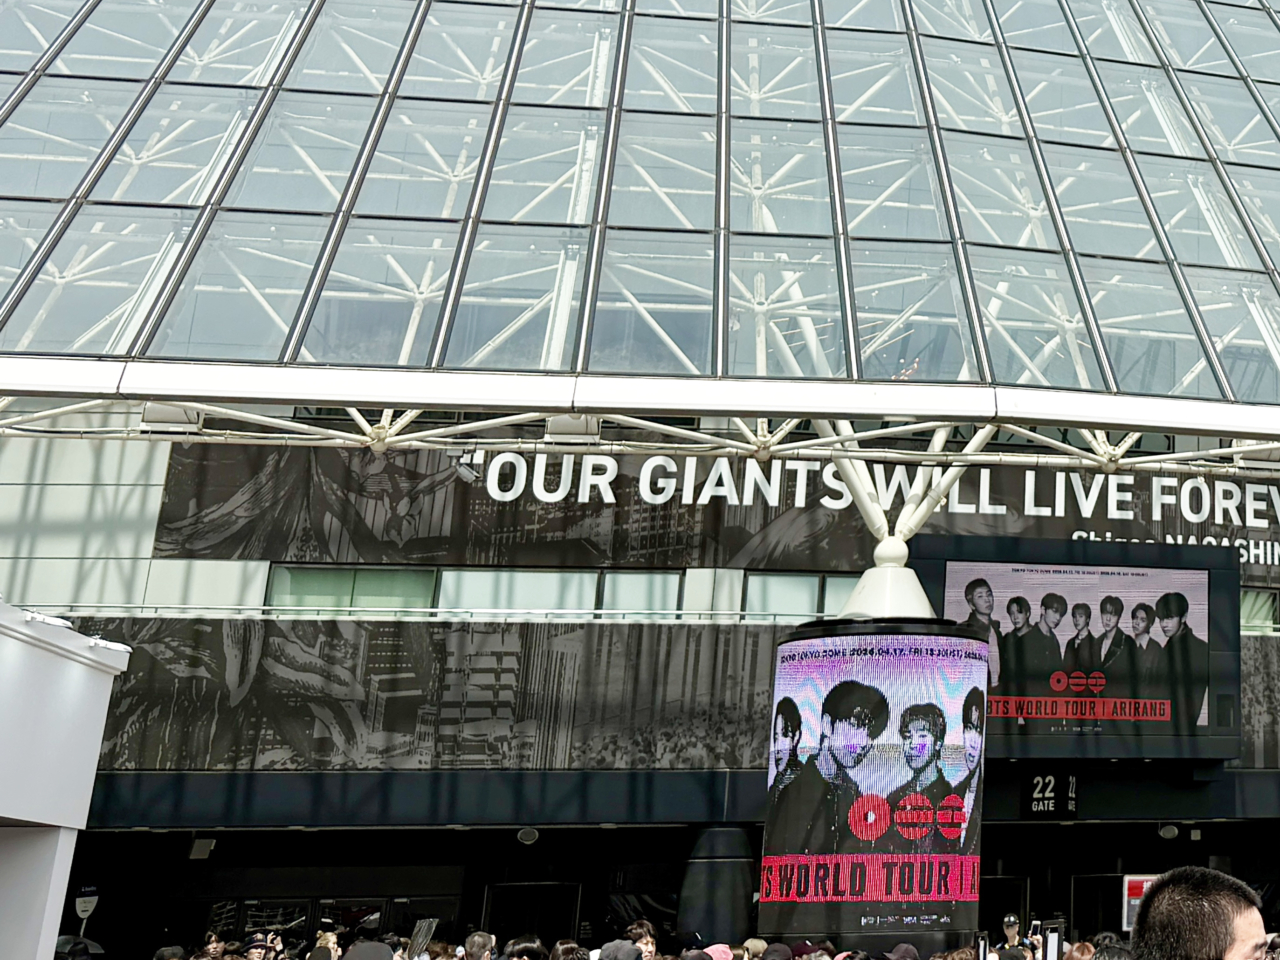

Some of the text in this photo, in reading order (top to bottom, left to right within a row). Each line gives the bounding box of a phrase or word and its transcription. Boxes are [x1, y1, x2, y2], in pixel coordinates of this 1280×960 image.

[638, 455, 854, 510] GIANTS
[1023, 469, 1134, 520] LIVE
[986, 699, 1010, 716] BTS
[1014, 699, 1058, 717] WORLD
[1065, 700, 1096, 717] TOUR
[1111, 701, 1166, 719] ARIRANG
[1032, 775, 1055, 799] 22
[1031, 799, 1056, 812] GATE
[779, 862, 867, 899] WORLD
[882, 861, 950, 895] TOUR
